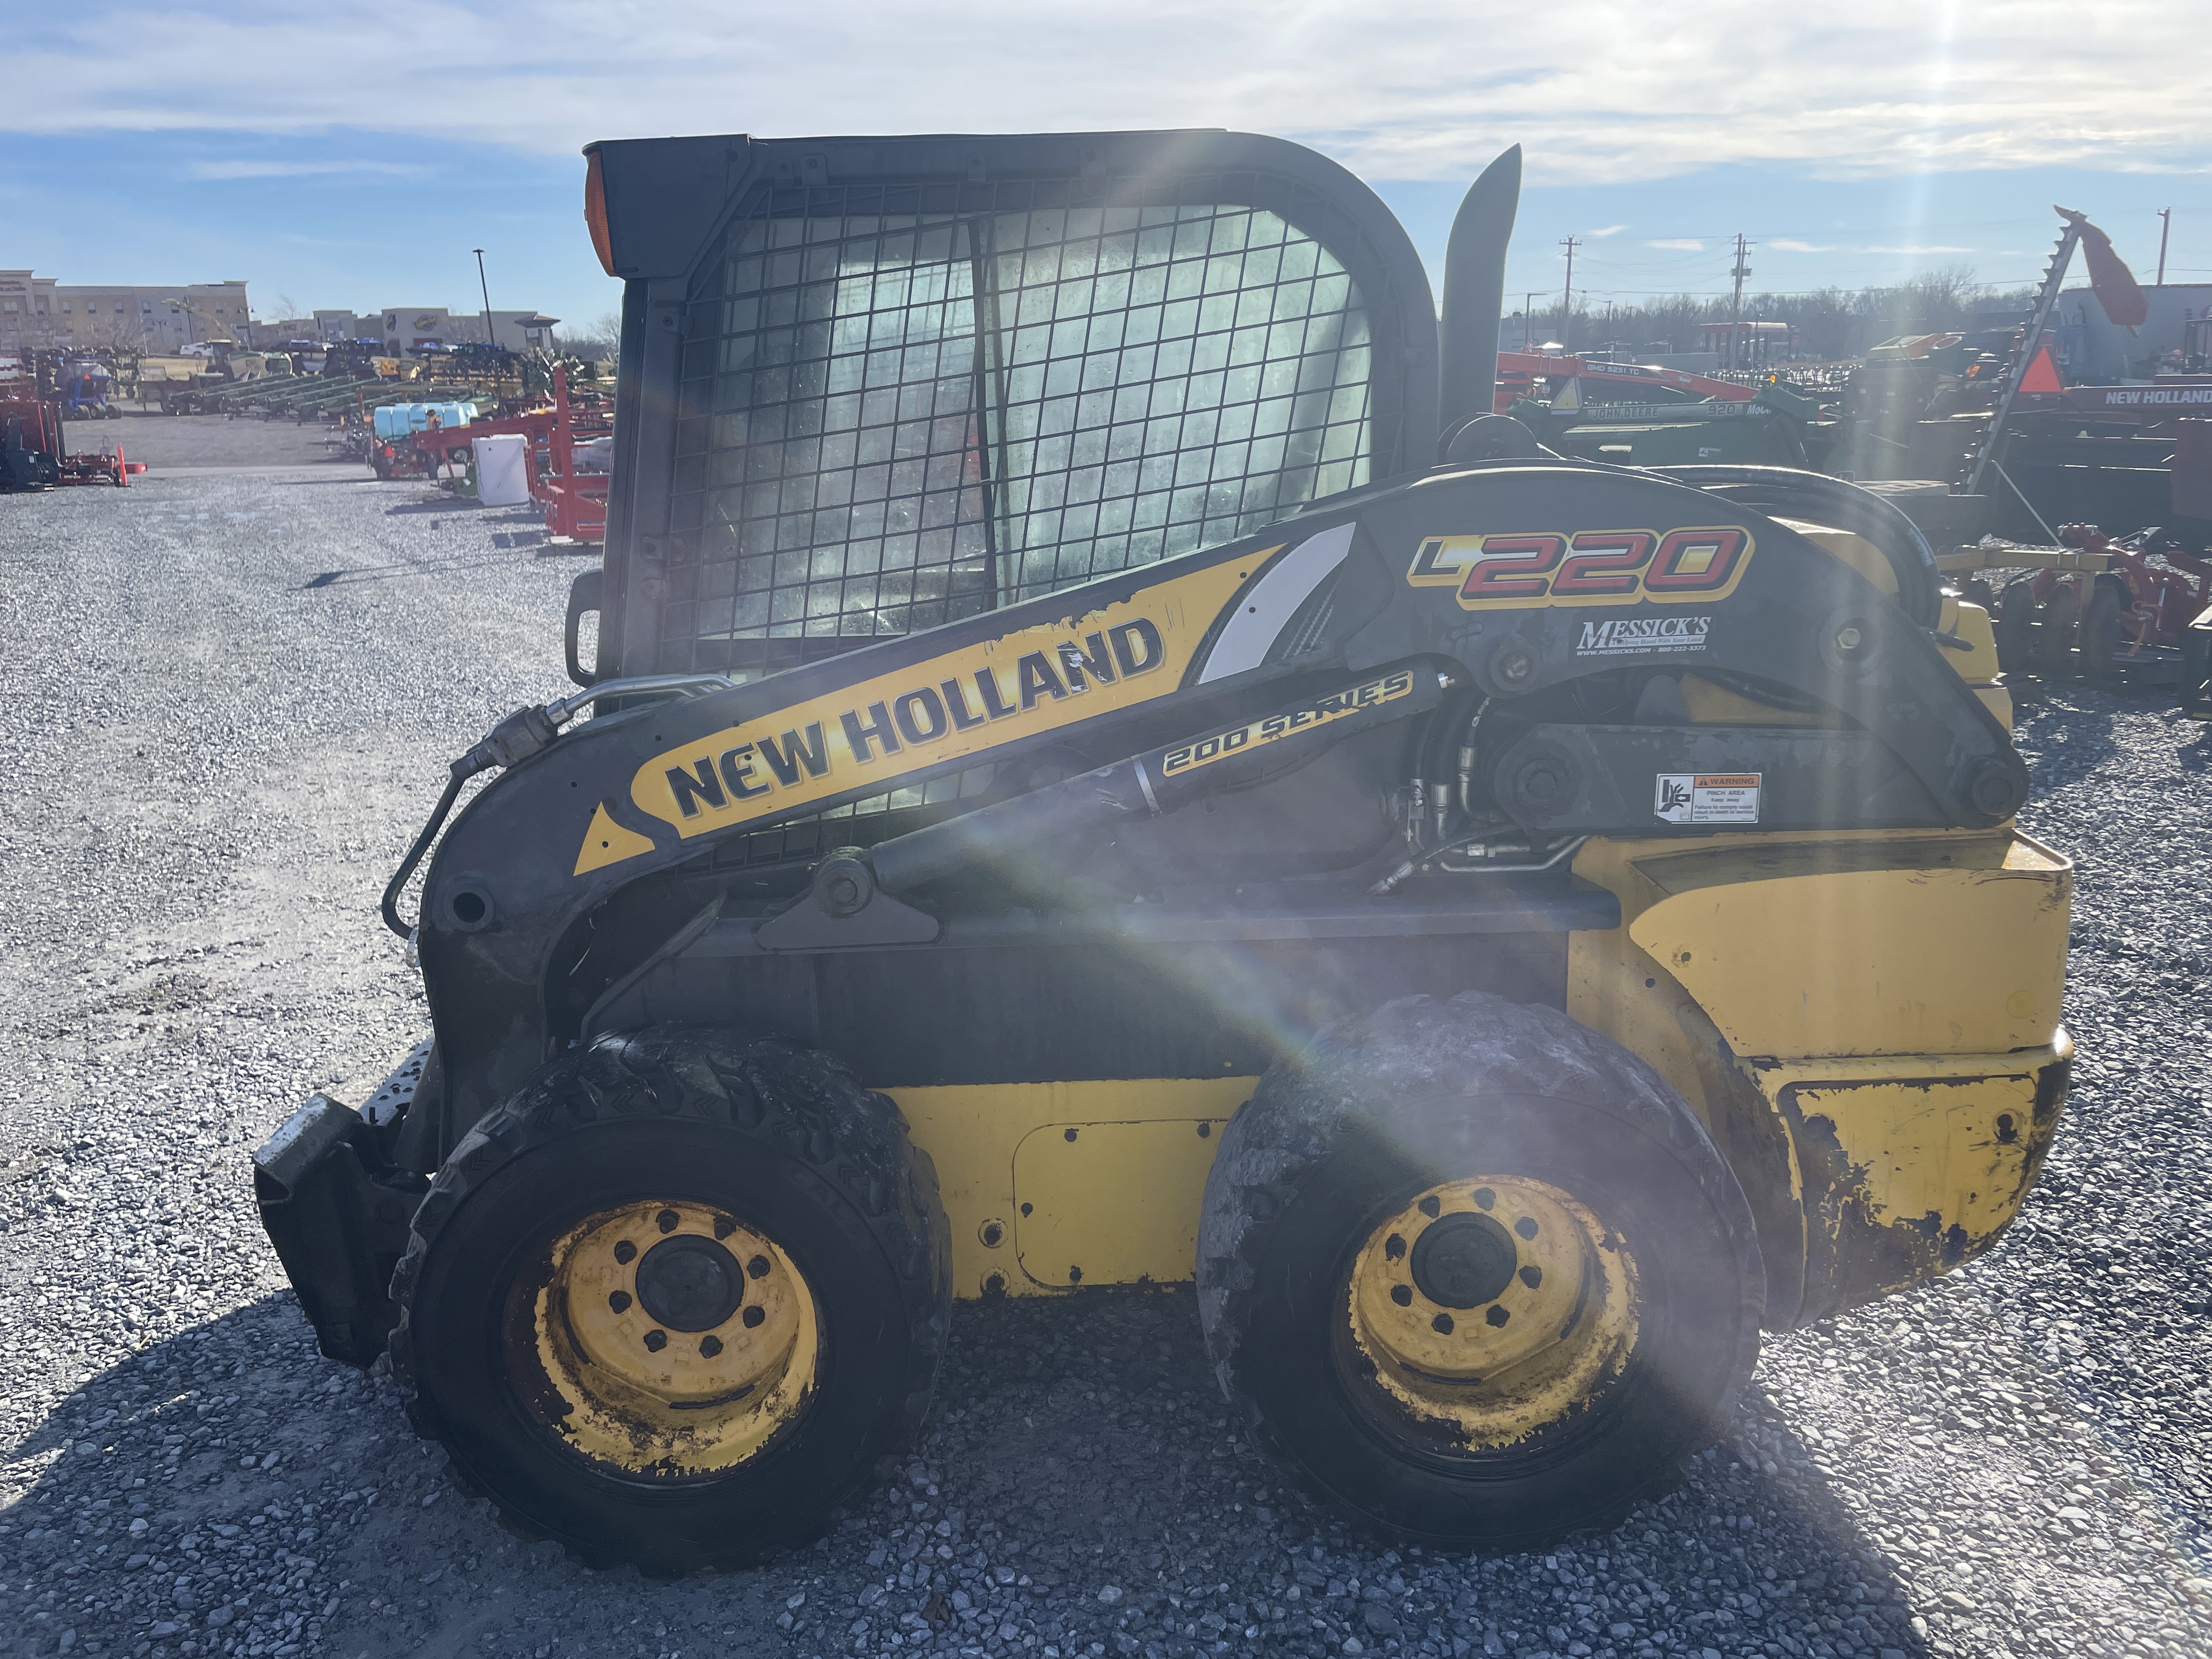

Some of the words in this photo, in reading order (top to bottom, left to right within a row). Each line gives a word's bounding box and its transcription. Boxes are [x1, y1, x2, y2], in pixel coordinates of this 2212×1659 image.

[1607, 366, 1626, 374] 5251
[2105, 391, 2141, 404] NEW
[2142, 390, 2212, 404] HOLLAND
[1593, 408, 1621, 420] JOHN
[1623, 407, 1659, 419] DEERE
[1707, 405, 1736, 416] 920
[1576, 616, 1712, 649] MESSICK'S
[1576, 647, 1651, 656] WWW.MESSICKS.COM
[664, 720, 830, 819] NEW
[839, 618, 1163, 763] HOLLAND
[1164, 727, 1250, 774] 200
[1261, 671, 1412, 739] SERIES
